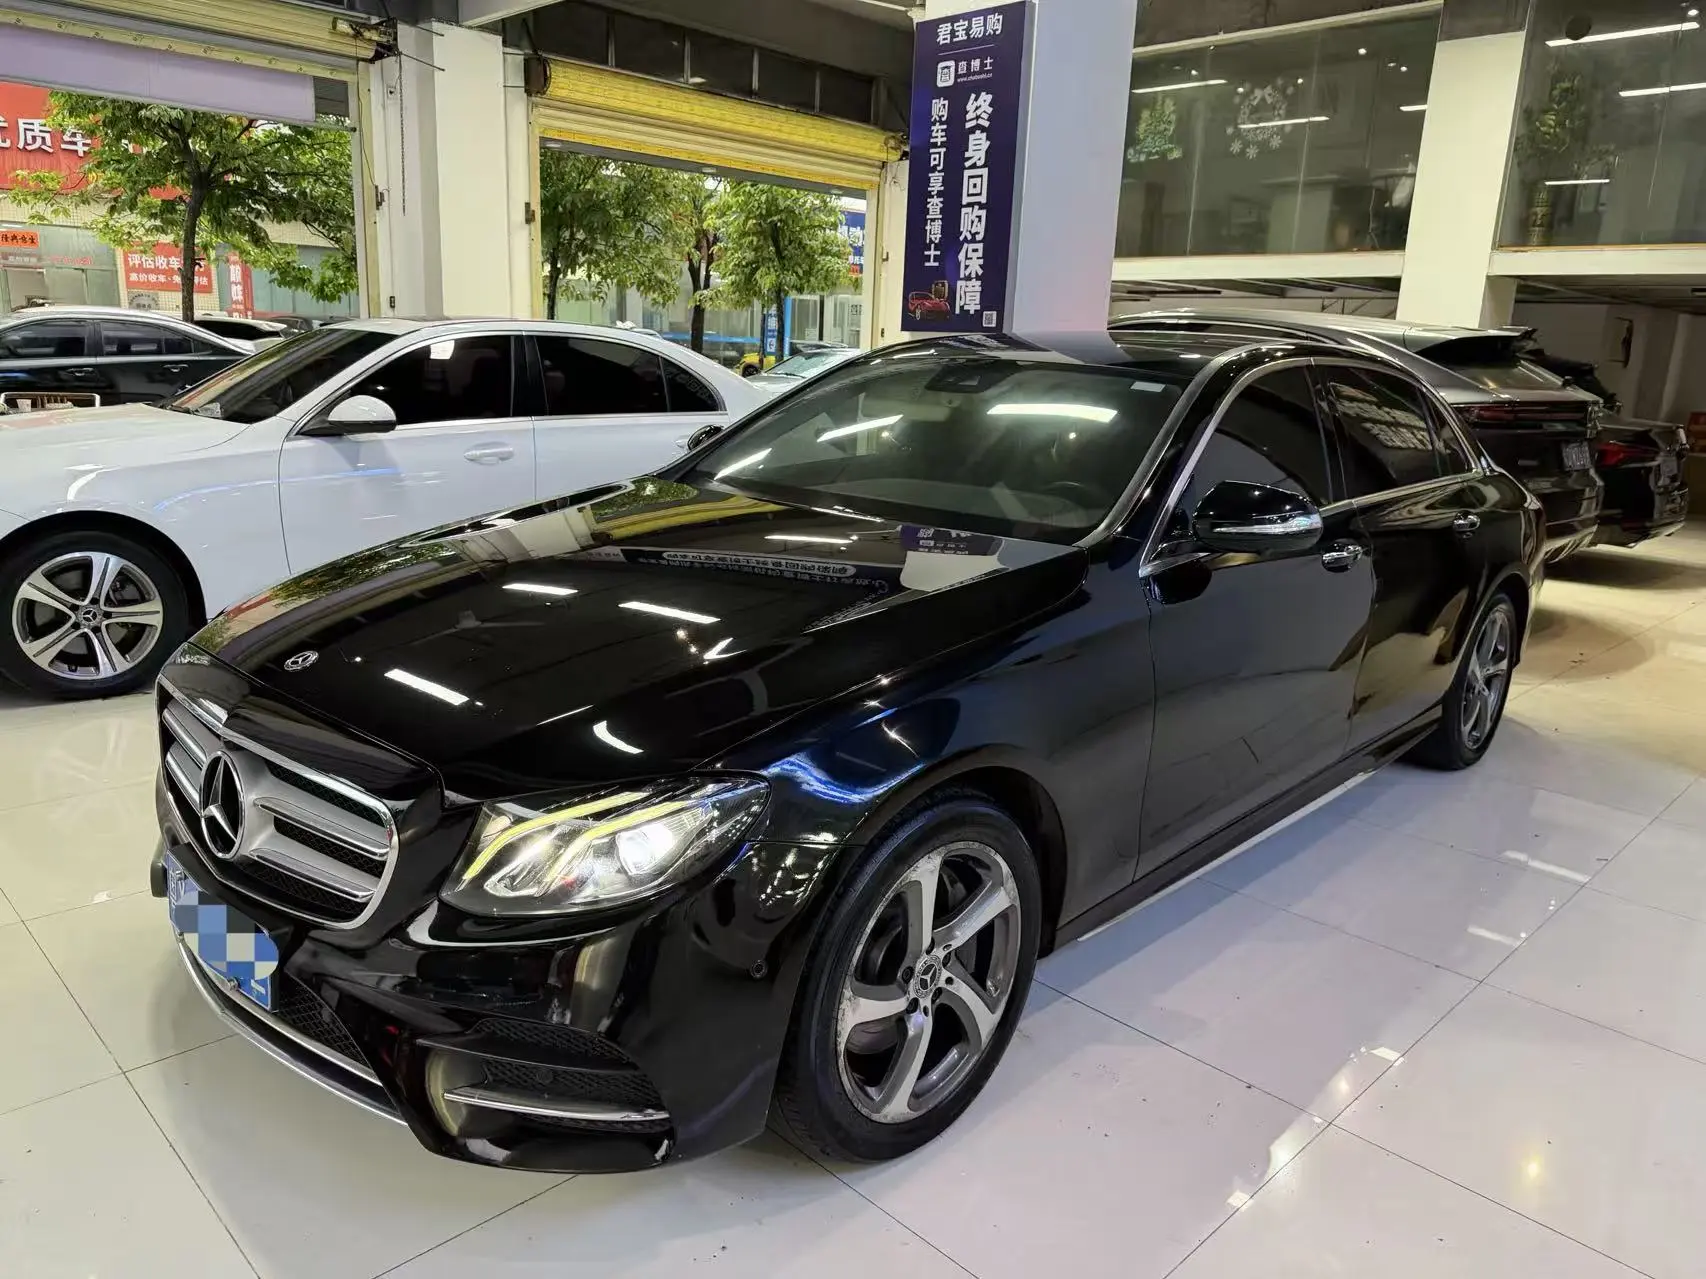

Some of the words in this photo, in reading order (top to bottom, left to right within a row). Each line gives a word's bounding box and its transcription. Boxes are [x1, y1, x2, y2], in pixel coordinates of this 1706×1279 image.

[936, 12, 1004, 46] 君宝易购
[957, 56, 994, 75] 查博士
[0, 114, 93, 157] 质车
[923, 96, 949, 267] 购车可享查博士
[954, 91, 994, 315] 终身回购保障
